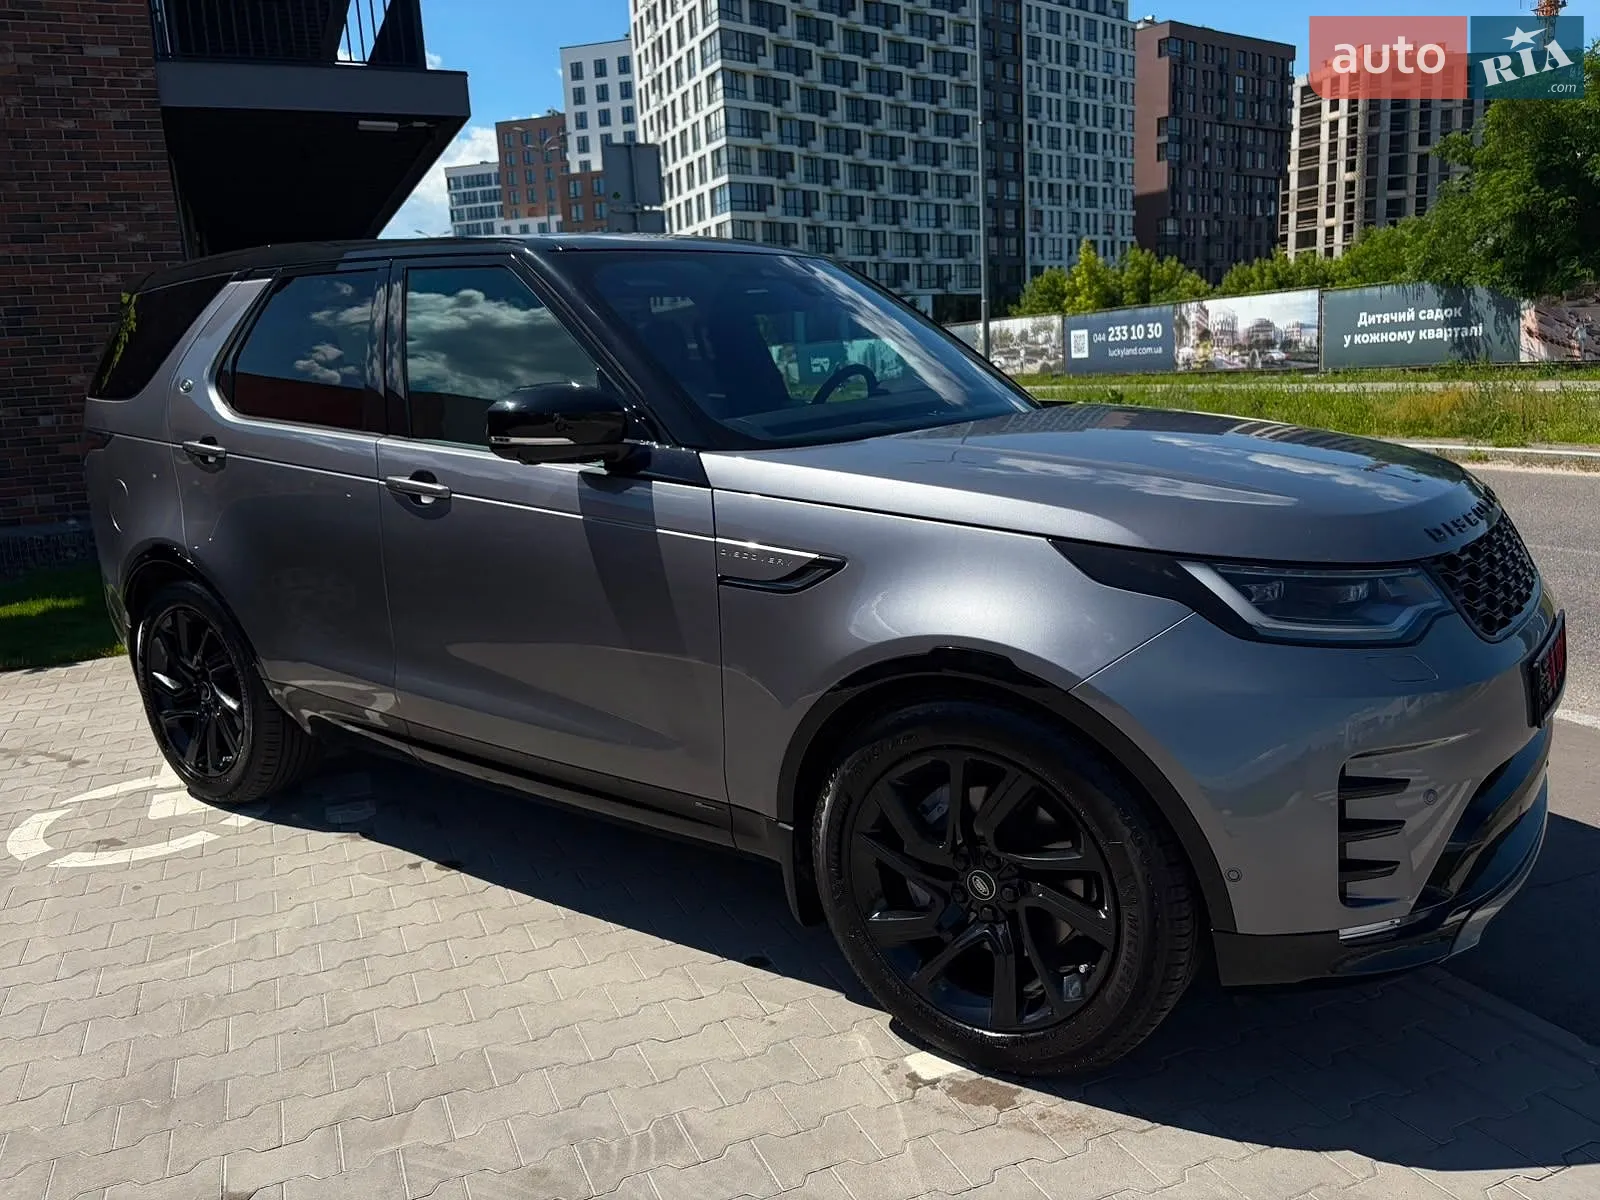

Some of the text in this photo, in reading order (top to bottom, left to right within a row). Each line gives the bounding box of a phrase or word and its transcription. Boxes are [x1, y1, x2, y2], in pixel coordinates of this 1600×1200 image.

[1357, 304, 1463, 328] Дитячий садок
[1092, 322, 1163, 344] 044 233 10 30
[1343, 322, 1483, 348] у кожному кварталі
[1108, 345, 1163, 358] luckyland.com.ua
